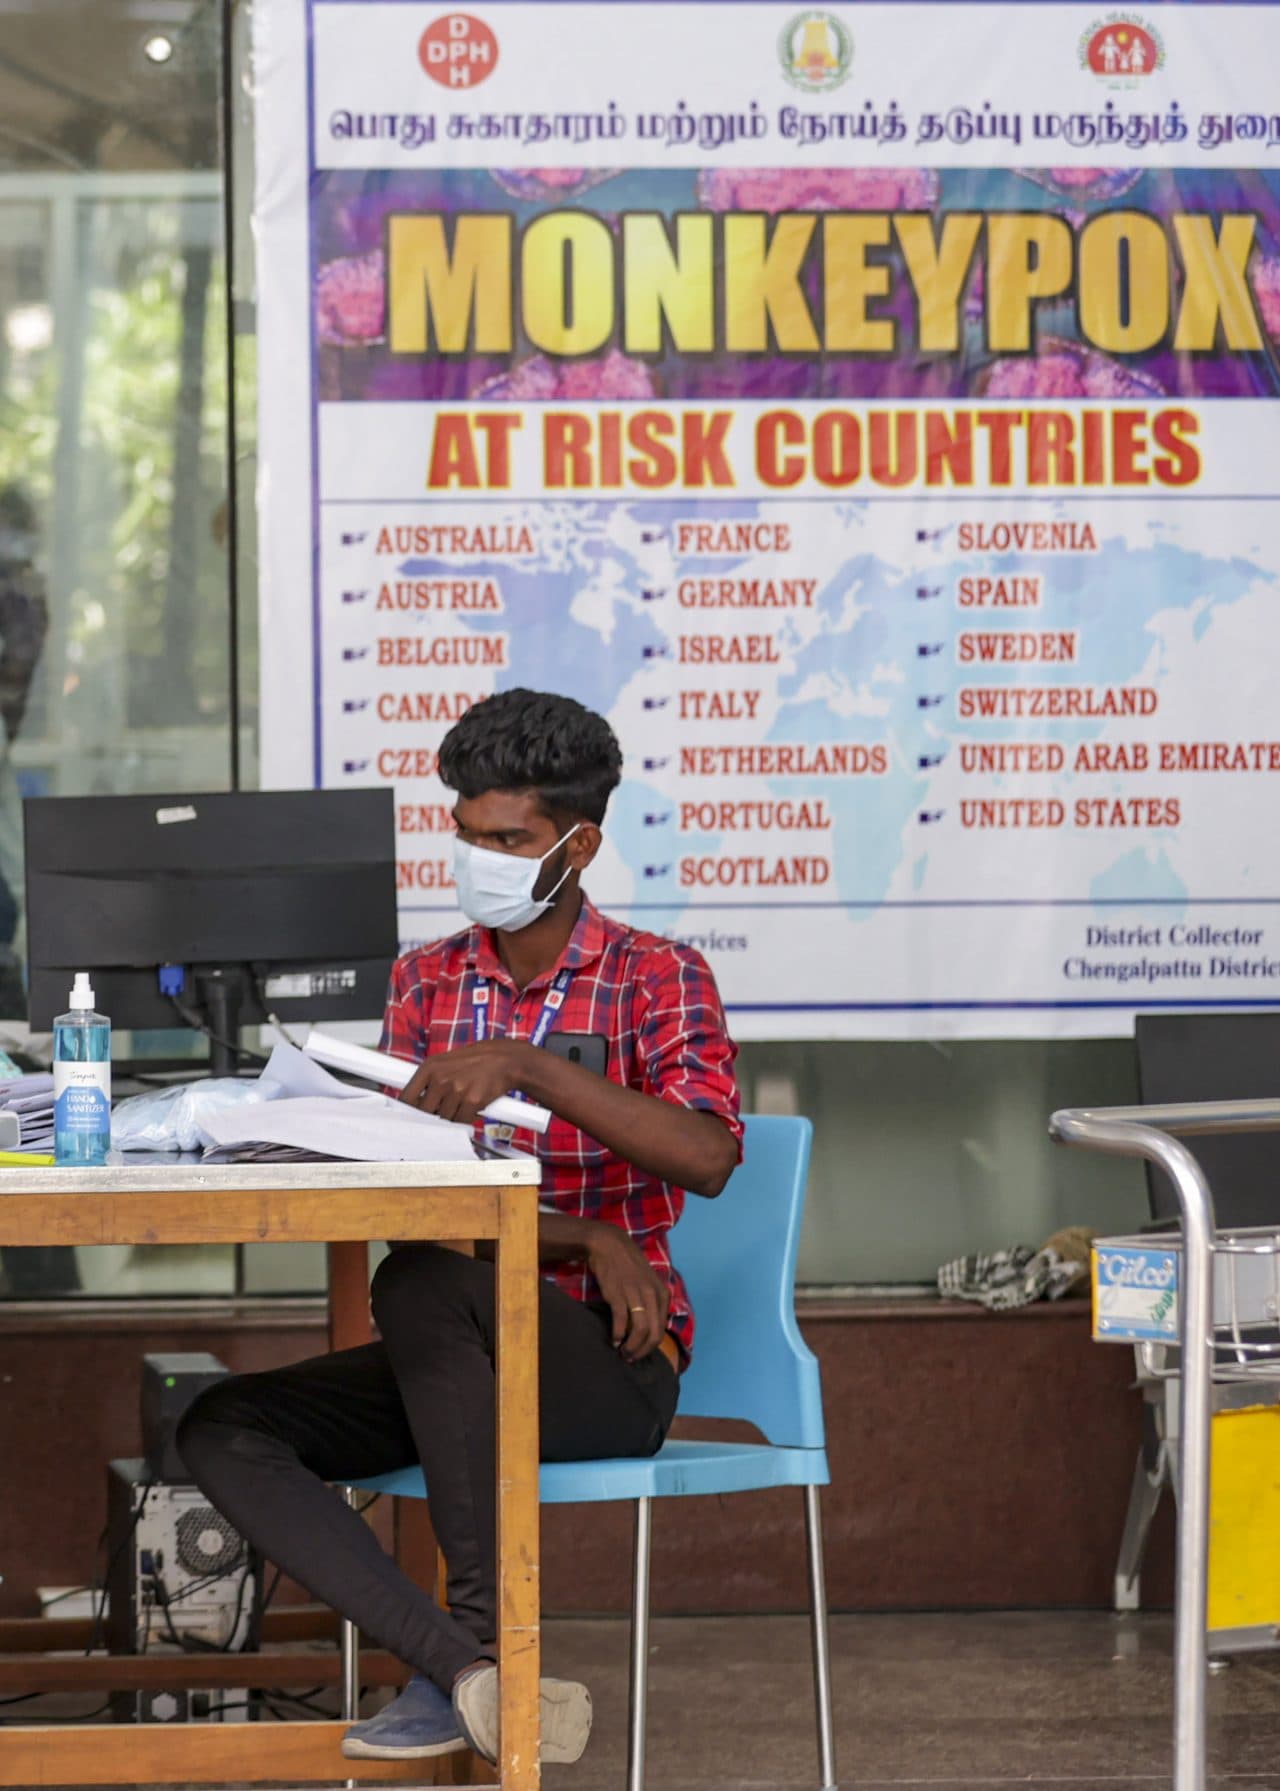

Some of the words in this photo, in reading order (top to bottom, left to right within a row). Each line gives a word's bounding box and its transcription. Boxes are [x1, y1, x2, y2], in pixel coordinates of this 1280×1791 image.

[427, 41, 490, 63] DPH
[330, 108, 435, 149] பொது
[446, 101, 626, 147] சுகாதாரம்
[636, 101, 768, 149] மற்றும்
[778, 101, 907, 147] நோய்த்
[915, 101, 1022, 147] தடுப்பு
[1032, 101, 1189, 150] மருந்துத்
[386, 210, 1266, 357] MONKEYPOX
[426, 411, 523, 490] AT
[541, 410, 736, 489] RISK
[753, 407, 1202, 489] COUNTRIES
[376, 526, 535, 553] AUSTRALIA
[677, 523, 792, 552] FRANCE
[958, 522, 1097, 551] SLOVENIA
[376, 582, 500, 610] AUSTRIA
[677, 580, 817, 609] GERMANY
[959, 577, 1040, 606] SPAIN
[377, 637, 505, 666] BELGIUM
[679, 636, 780, 664] ISRAEL
[959, 633, 1076, 662] SWEDEN
[377, 693, 487, 722] CANAD
[679, 691, 762, 720] ITALY
[959, 688, 1158, 717] SWITZERLAND
[679, 746, 888, 775] NETHERLANDS
[960, 744, 1065, 773] UNITED
[1074, 742, 1149, 772] ARAB
[1158, 741, 1280, 772] EMIRATE
[679, 801, 831, 830] PORTUGAL
[960, 800, 1065, 828] UNITED
[1074, 798, 1181, 828] STATES
[679, 857, 830, 886] SCOTLAND
[1085, 925, 1161, 947] District
[1169, 924, 1264, 947] Collector
[1062, 956, 1202, 983] Chengalpattu
[1208, 955, 1280, 979] Distric
